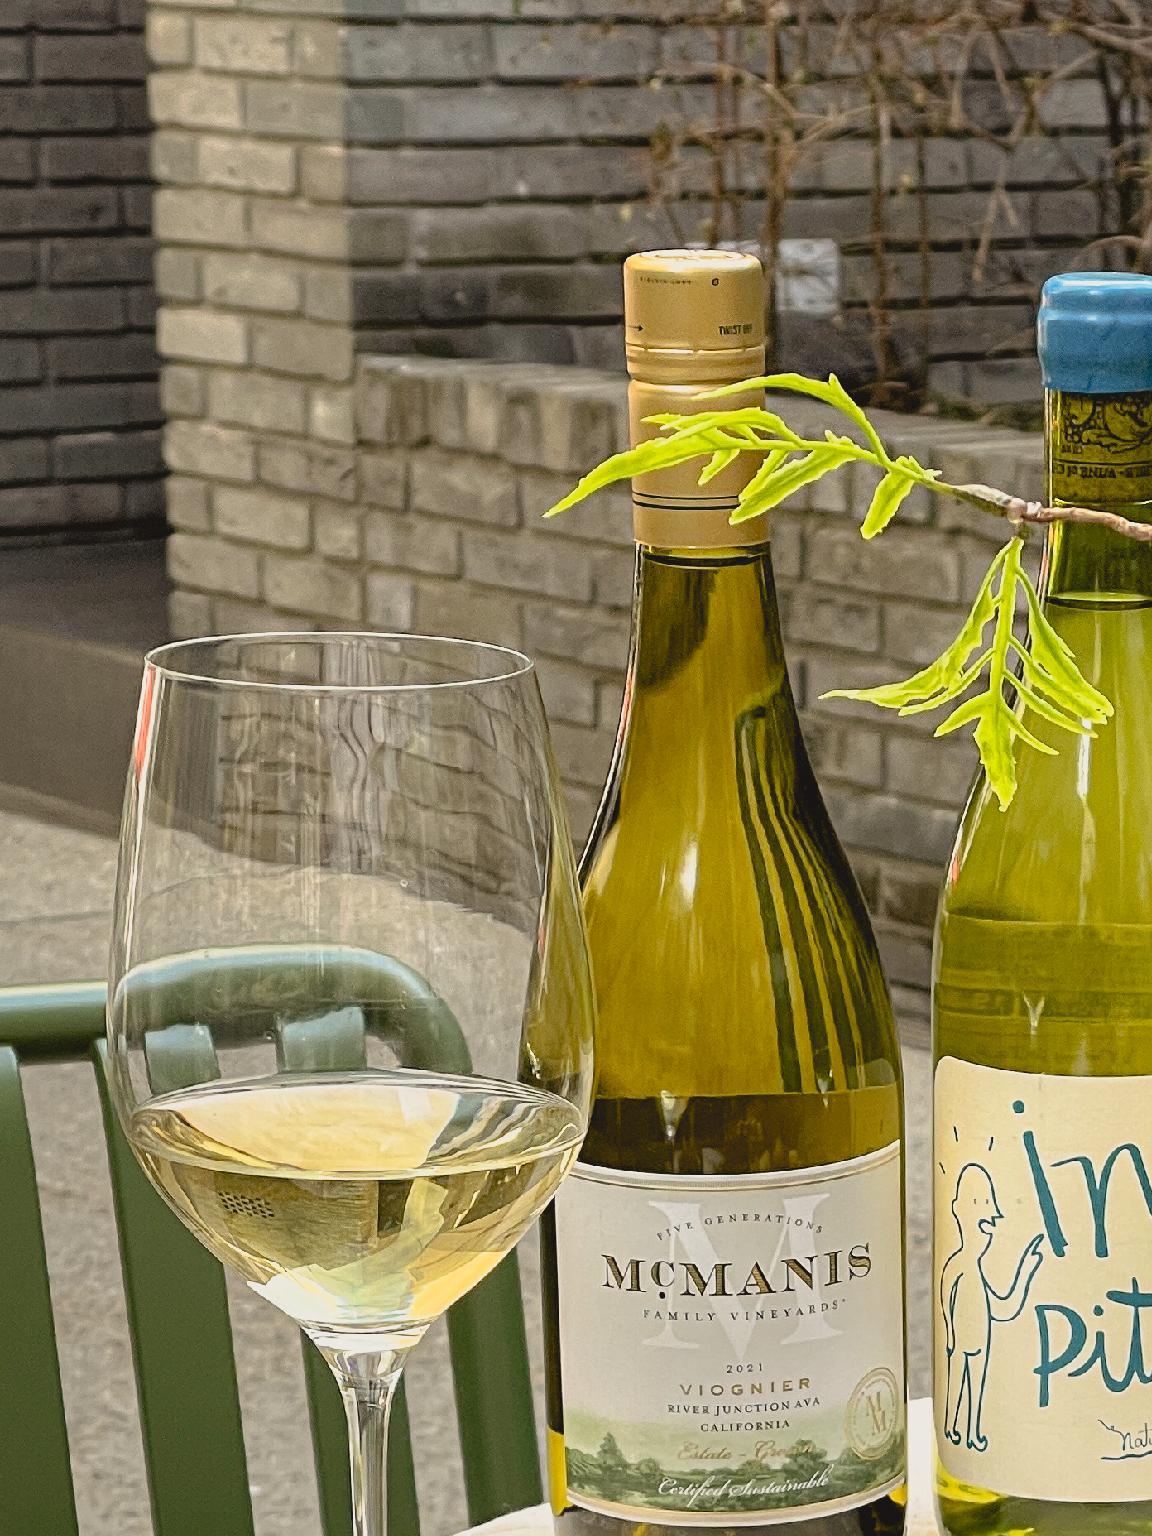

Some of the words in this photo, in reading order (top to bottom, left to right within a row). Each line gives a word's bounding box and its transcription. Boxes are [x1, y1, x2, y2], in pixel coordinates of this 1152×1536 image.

[704, 1213, 824, 1235] GENERATIONS
[643, 1308, 718, 1322] FAMILY
[729, 1299, 840, 1322] VINEYARDS
[725, 1362, 764, 1375] 2021
[679, 1377, 811, 1397] VIOGNIER
[667, 1403, 711, 1415] RIVER
[713, 1400, 791, 1416] JUNCTION
[793, 1397, 820, 1410] AVA
[700, 1419, 791, 1433] CALIFORNIA
[658, 1476, 731, 1508] Certified
[728, 1463, 835, 1499] Sustainable
